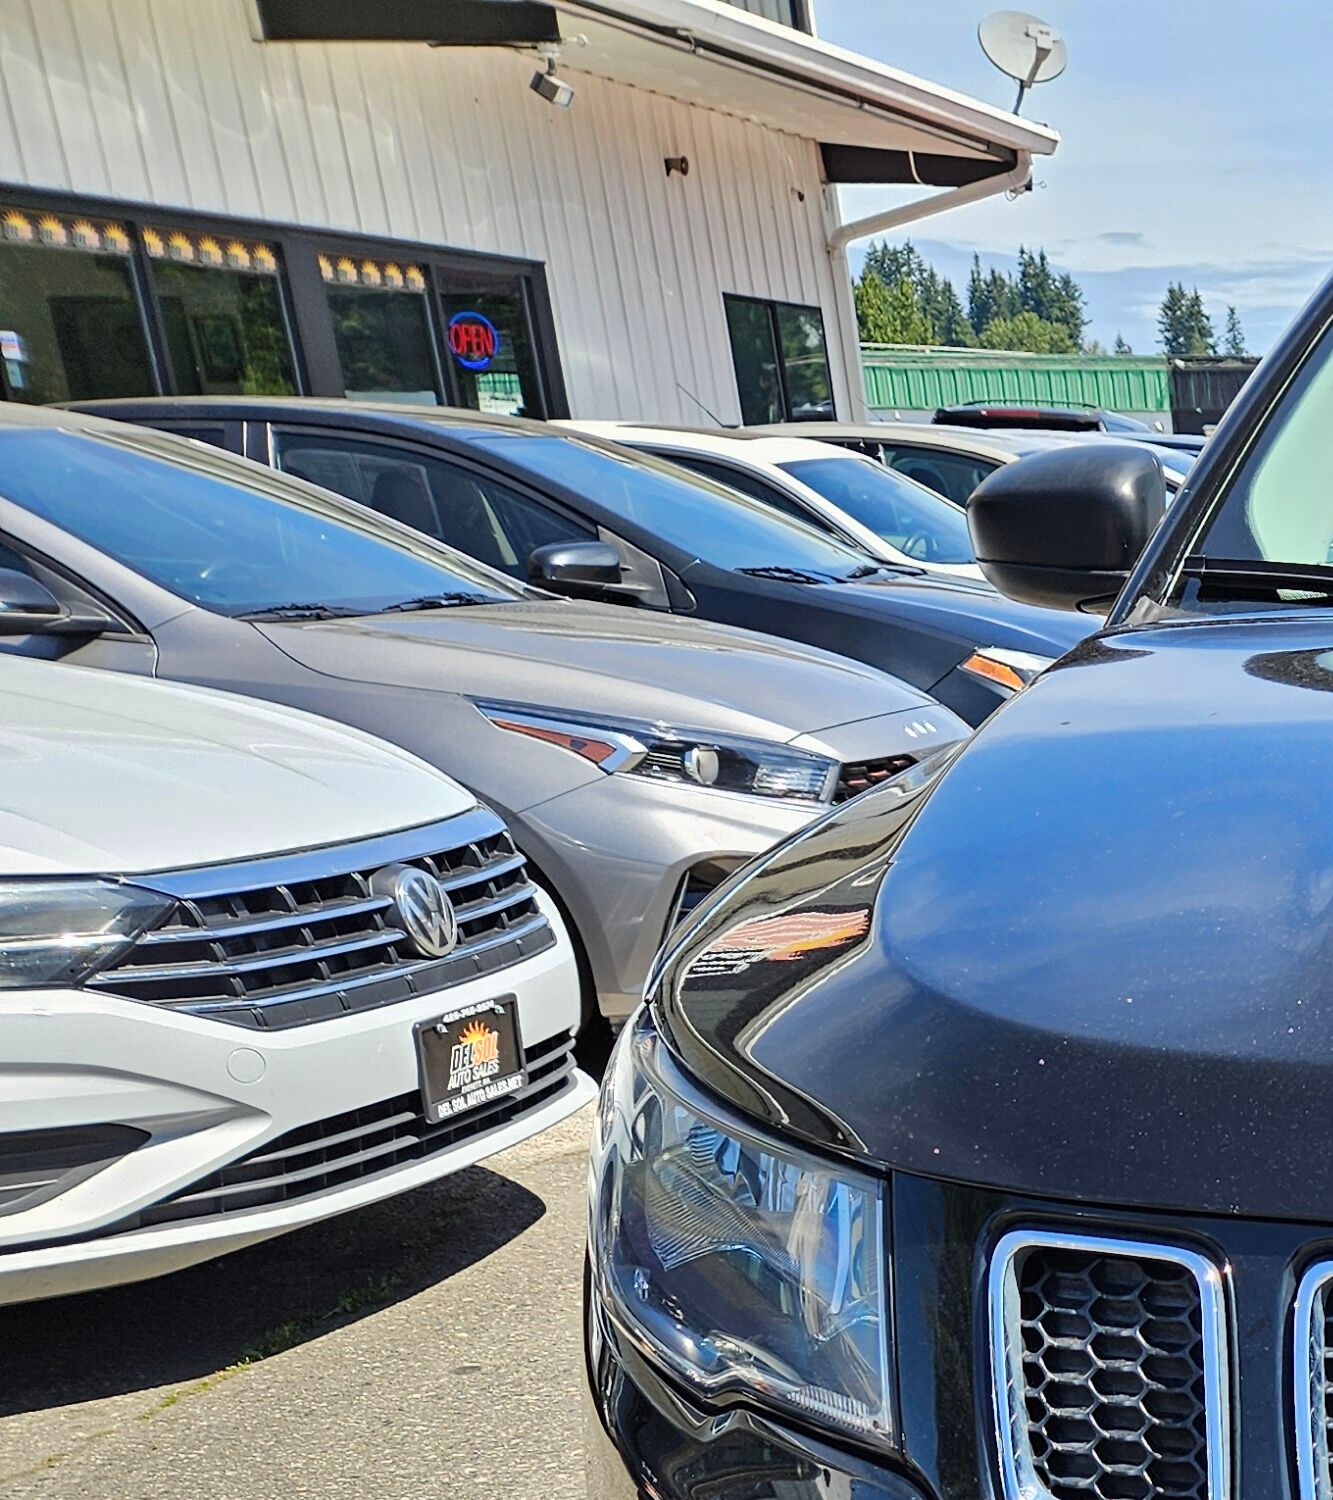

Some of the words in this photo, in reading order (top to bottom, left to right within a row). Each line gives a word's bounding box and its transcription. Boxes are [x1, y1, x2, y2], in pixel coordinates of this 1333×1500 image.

[449, 322, 494, 357] OPEN
[447, 1067, 471, 1090] AUTO
[472, 1058, 500, 1080] SALES
